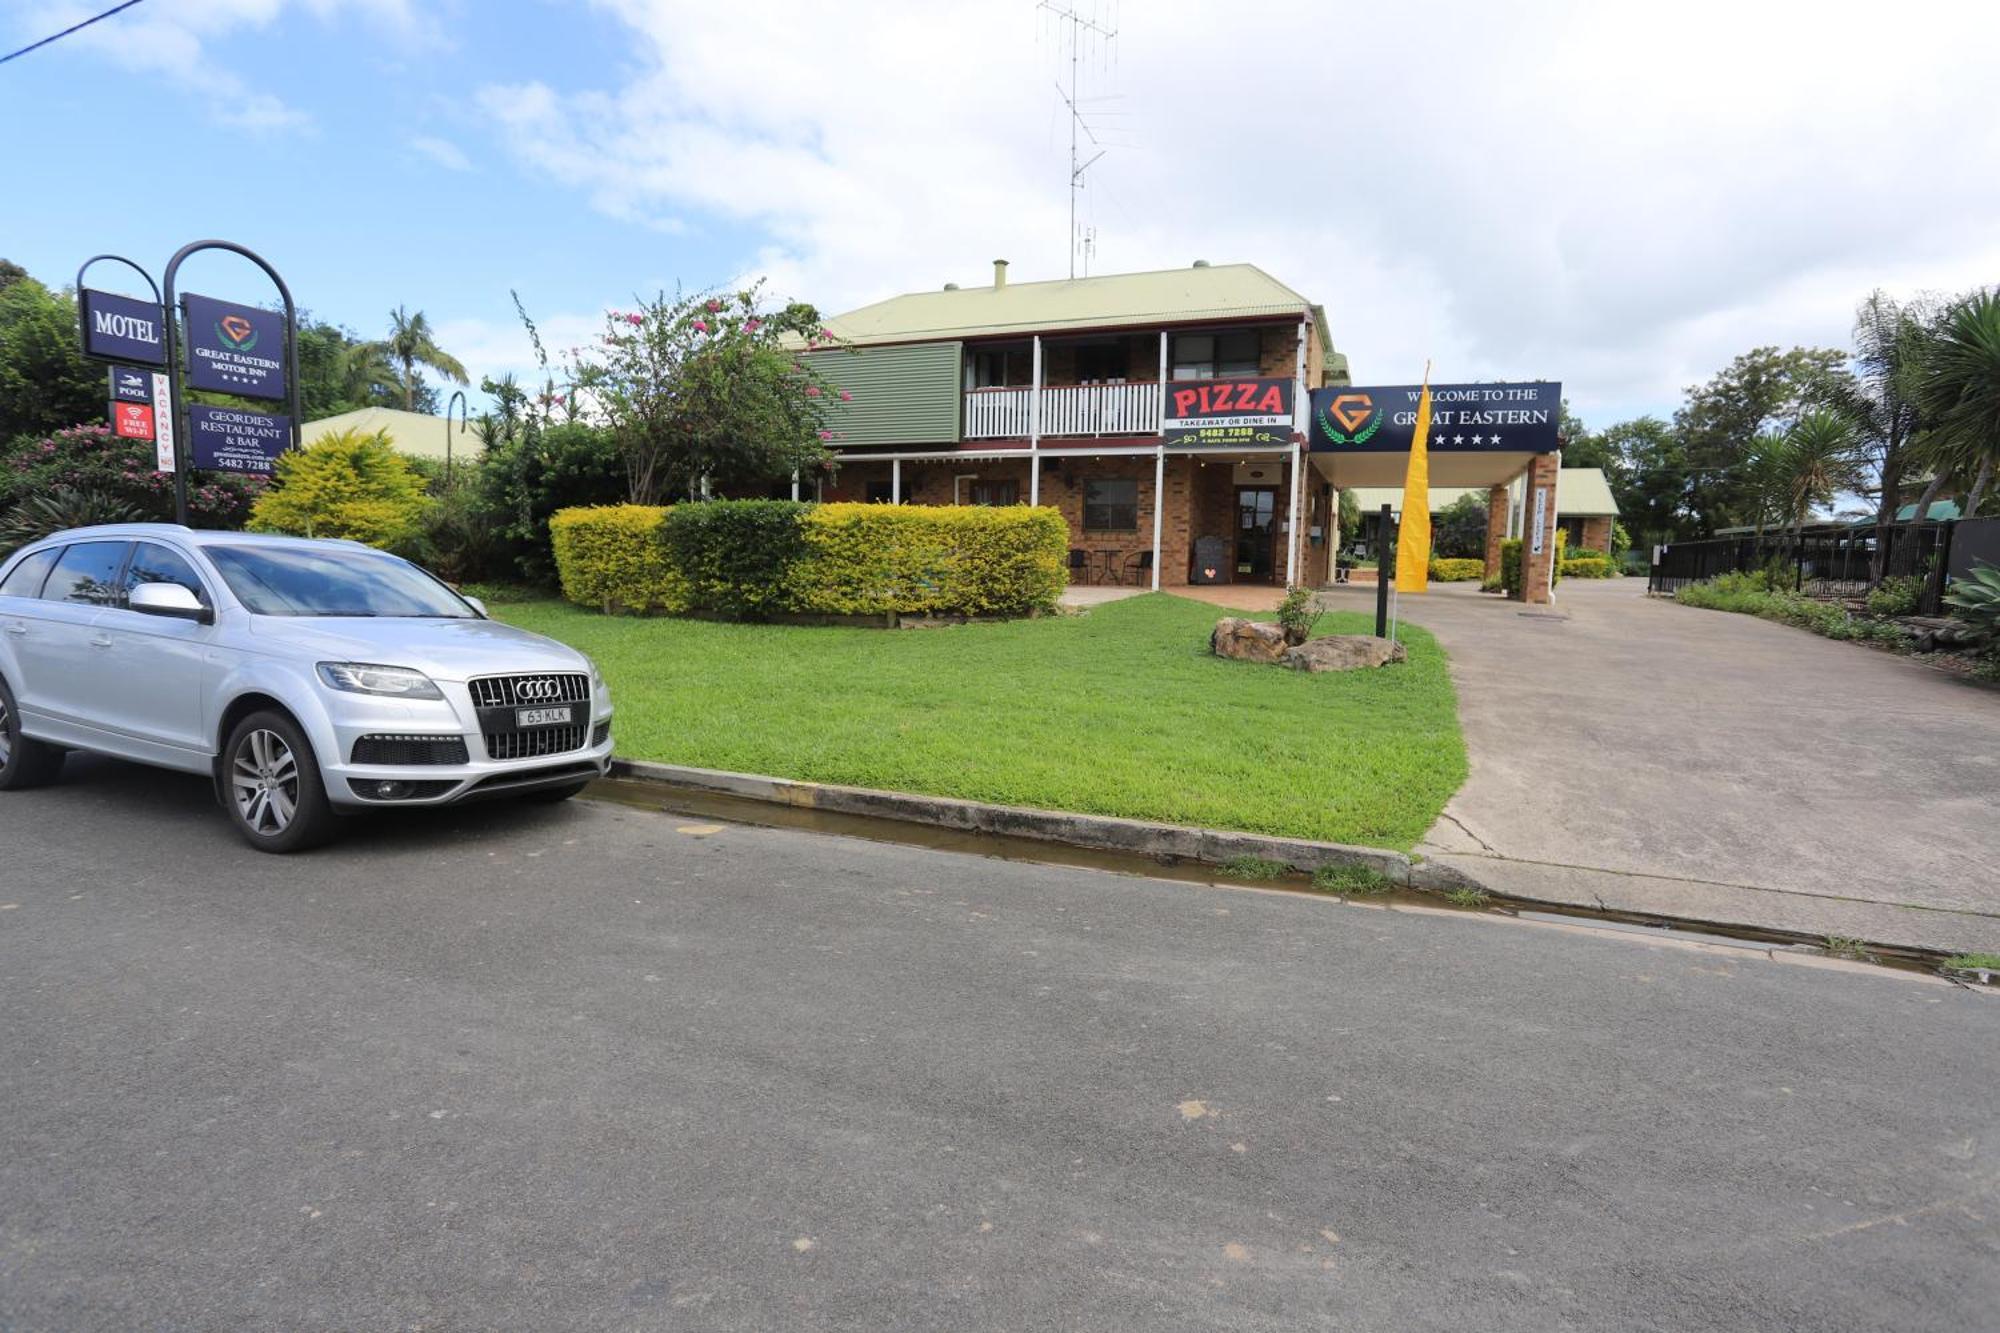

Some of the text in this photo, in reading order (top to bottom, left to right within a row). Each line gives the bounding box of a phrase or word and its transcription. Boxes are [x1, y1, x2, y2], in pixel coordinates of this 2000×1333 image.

[94, 310, 159, 344] MOTEL
[195, 347, 280, 369] GREAT EASTERN
[211, 361, 267, 377] MOTOR INN
[119, 387, 148, 398] POOL
[1173, 383, 1285, 417] PIZZA
[1407, 389, 1538, 402] WLCOME TO THE
[157, 377, 170, 452] VACANCY
[208, 411, 274, 427] GEORDIE'S
[1180, 419, 1225, 427] TAKEAWAY
[1228, 418, 1241, 426] OR
[1243, 417, 1263, 425] DINE
[1393, 410, 1548, 426] GRAT EASTERN
[123, 419, 147, 428] FREE
[200, 421, 282, 439] RESTAURANT
[1199, 429, 1225, 437] 5482
[225, 436, 260, 447] & BAR
[218, 459, 271, 471] 5482 7288
